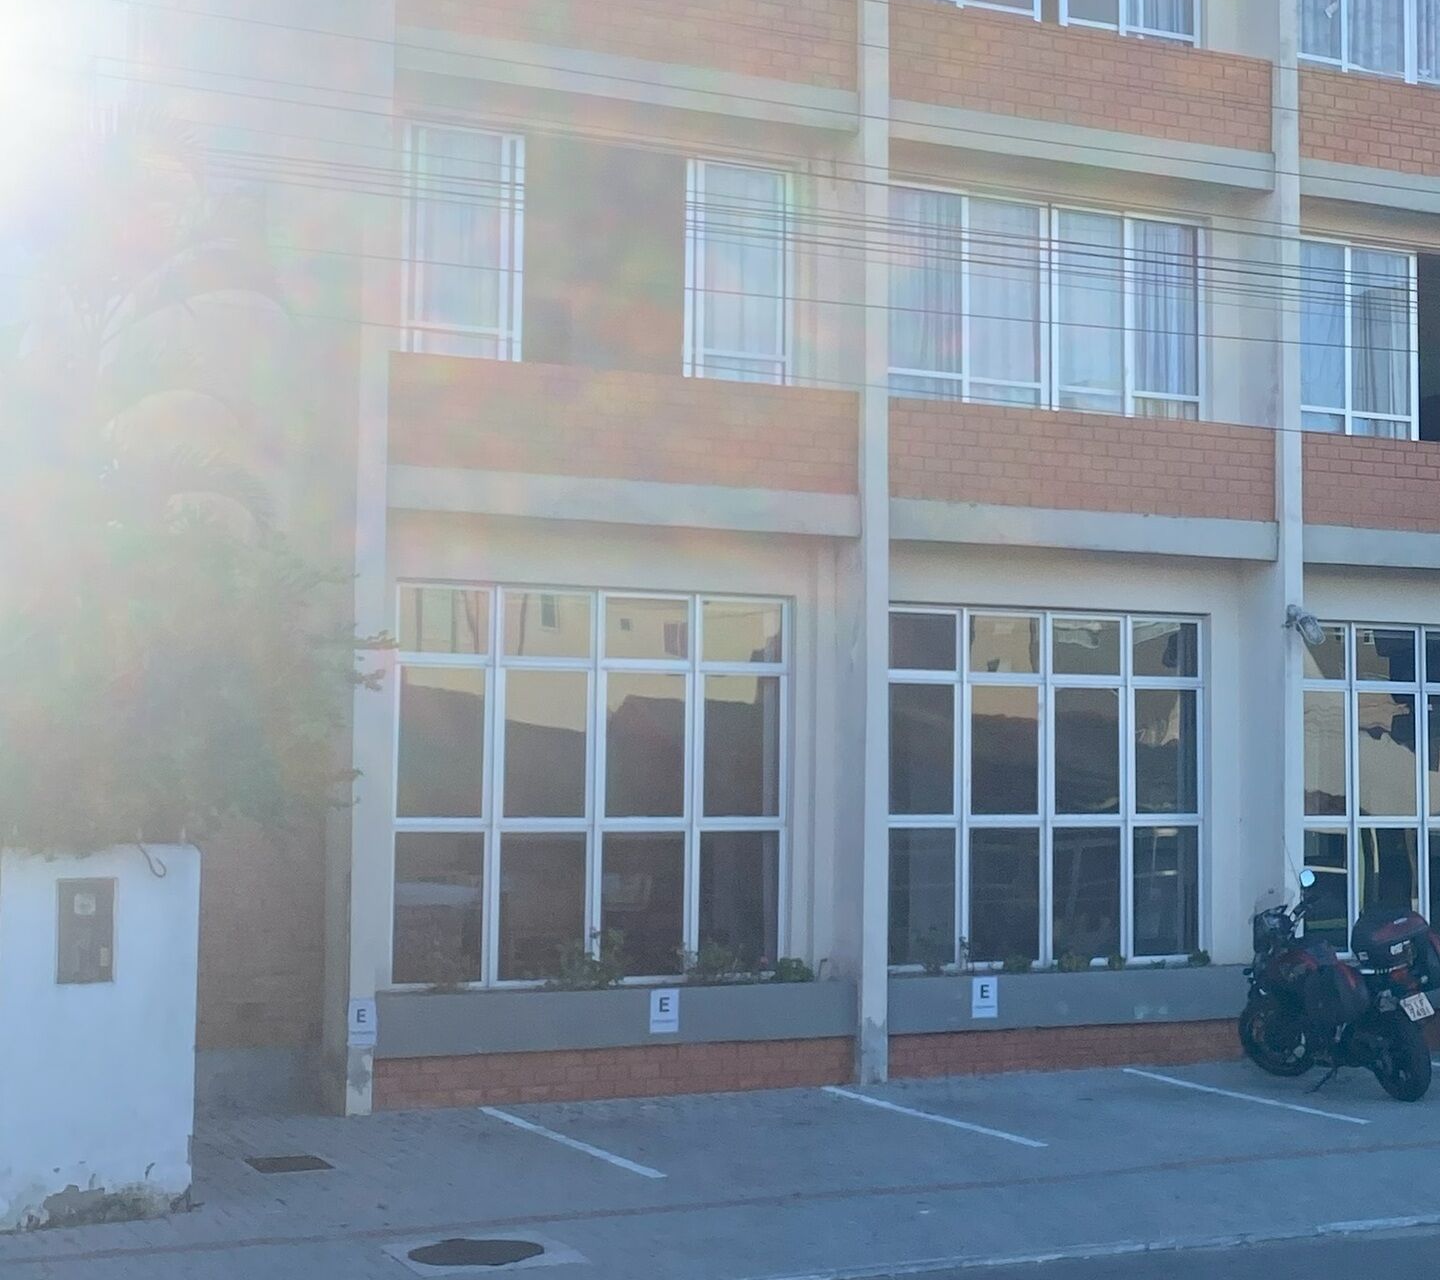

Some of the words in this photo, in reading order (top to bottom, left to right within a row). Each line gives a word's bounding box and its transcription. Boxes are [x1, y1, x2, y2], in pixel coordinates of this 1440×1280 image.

[980, 984, 990, 999] E
[659, 997, 670, 1012] E
[356, 1008, 367, 1023] E
